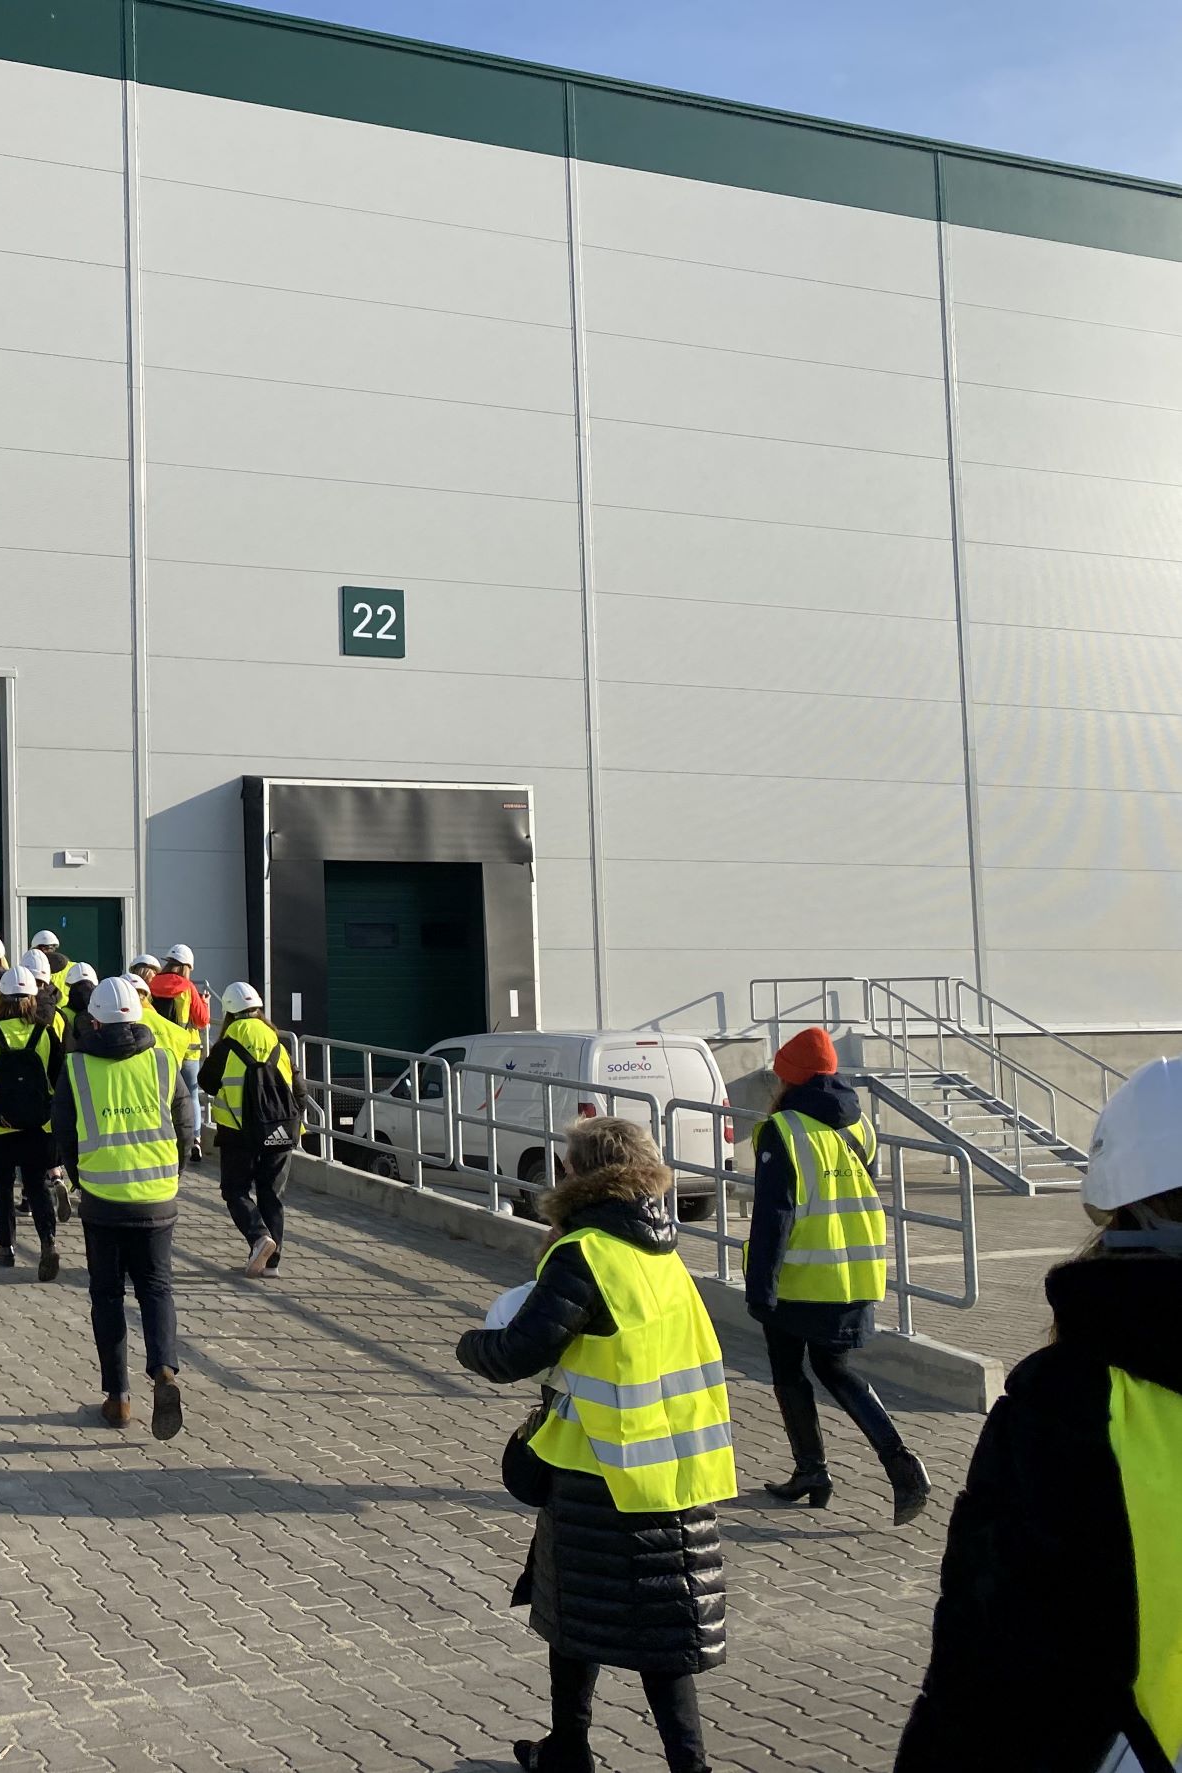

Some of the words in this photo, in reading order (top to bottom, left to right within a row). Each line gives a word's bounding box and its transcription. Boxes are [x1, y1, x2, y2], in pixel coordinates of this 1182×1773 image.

[352, 602, 397, 640] 22
[607, 1060, 652, 1073] sodexo
[264, 1138, 293, 1146] adidas
